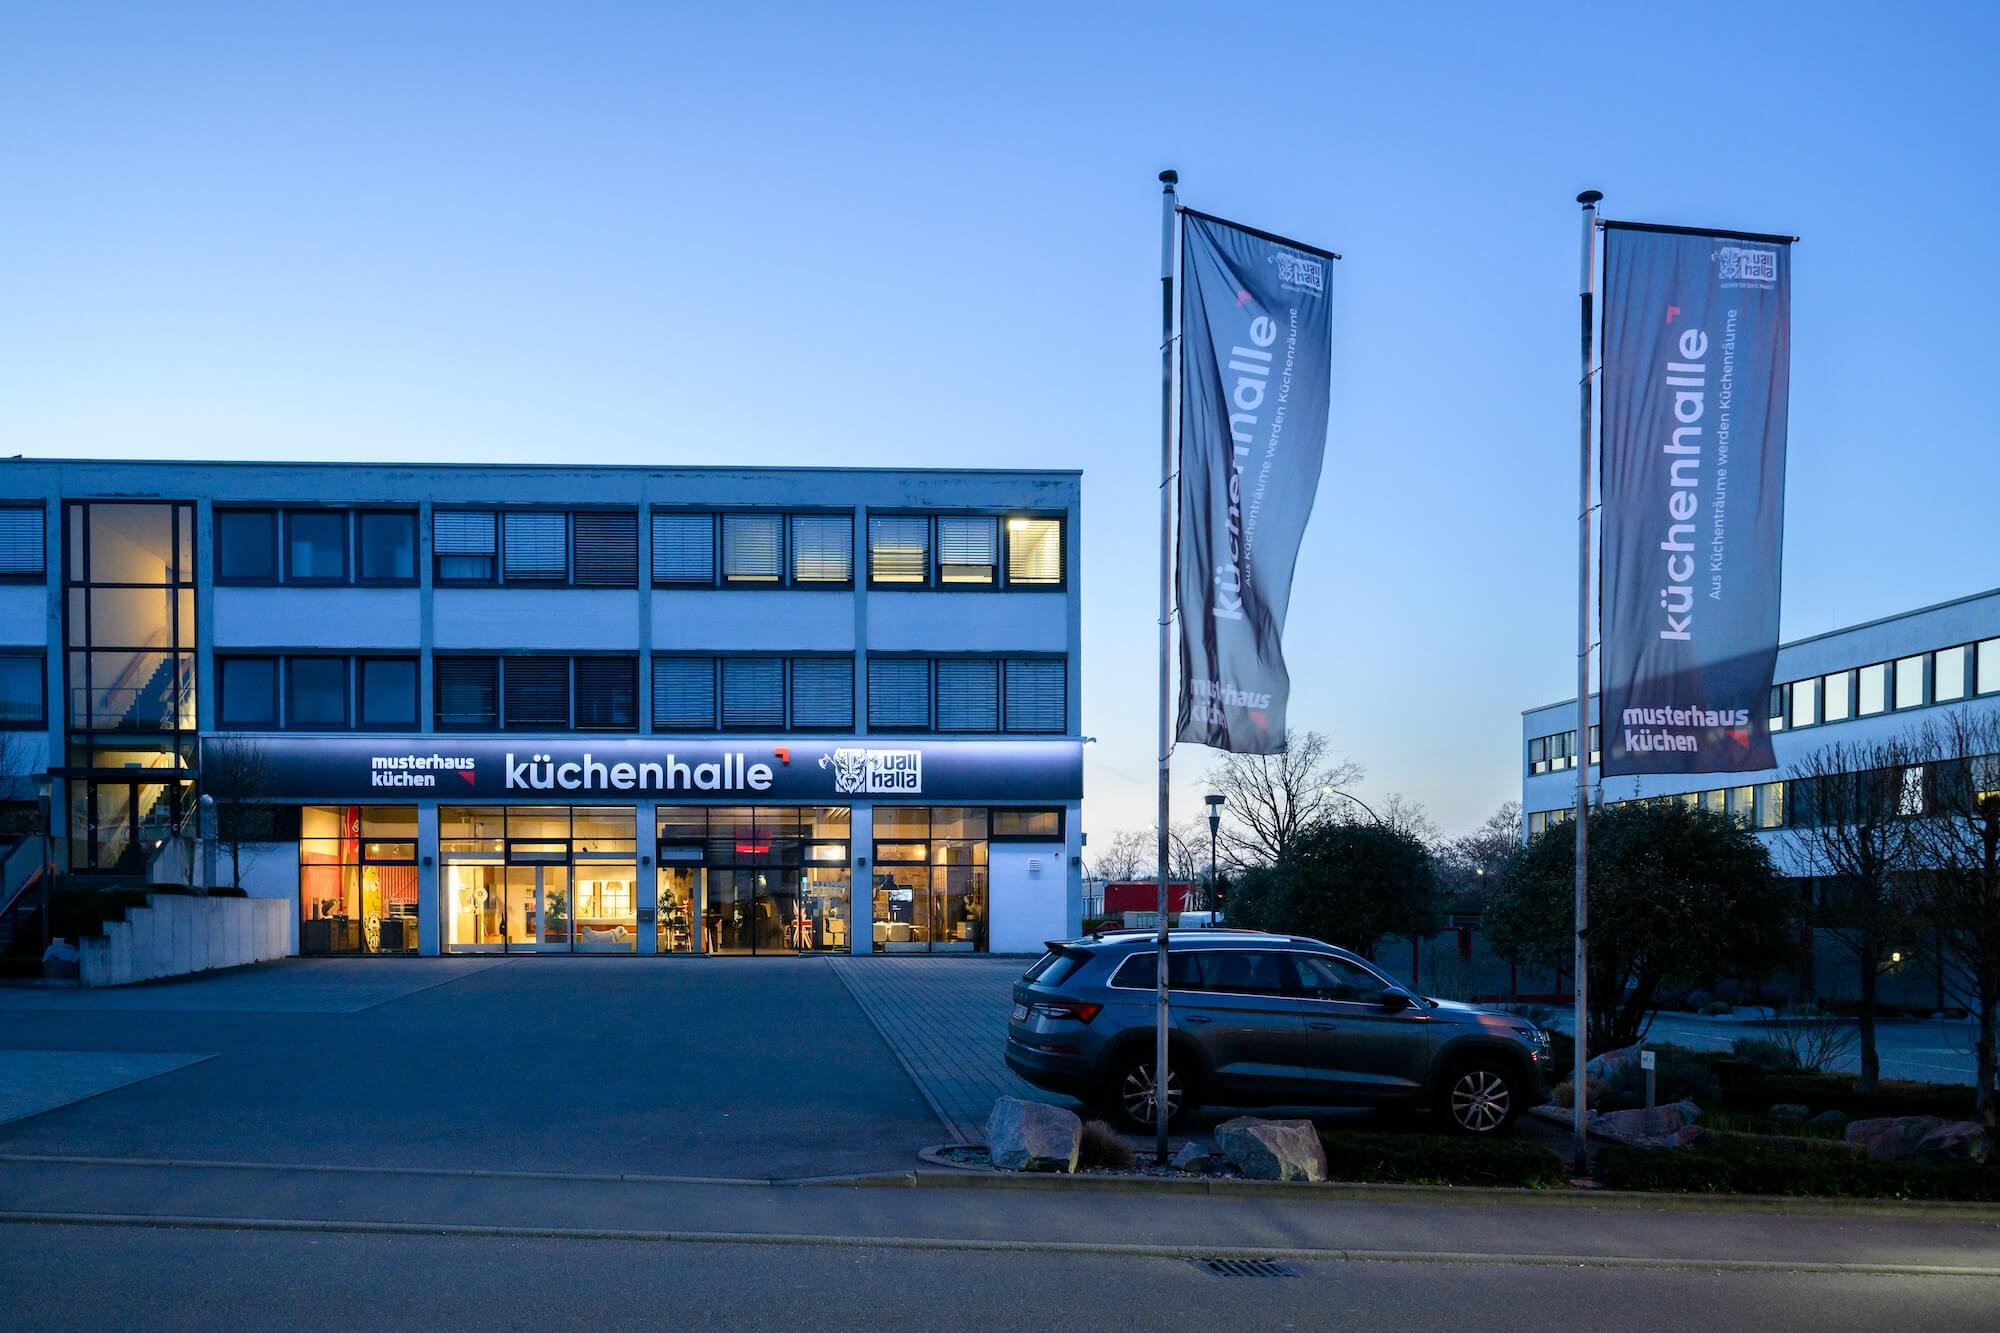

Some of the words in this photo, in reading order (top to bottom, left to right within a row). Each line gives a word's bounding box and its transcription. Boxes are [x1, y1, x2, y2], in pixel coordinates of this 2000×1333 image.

[1719, 309, 1738, 409] Küchenräume
[1264, 406, 1287, 459] werden
[1278, 307, 1299, 403] Küchenräume
[1717, 413, 1730, 466] werden
[1659, 328, 1709, 641] küchenhalle
[1709, 469, 1728, 572] Küchenträume
[1709, 575, 1721, 600] Aus
[1623, 704, 1749, 727] musterhaus
[1625, 729, 1698, 753] küchen
[371, 754, 475, 771] musterhaus
[371, 770, 436, 787] küchen
[505, 752, 774, 791] küchenhalle
[871, 771, 917, 788] halla
